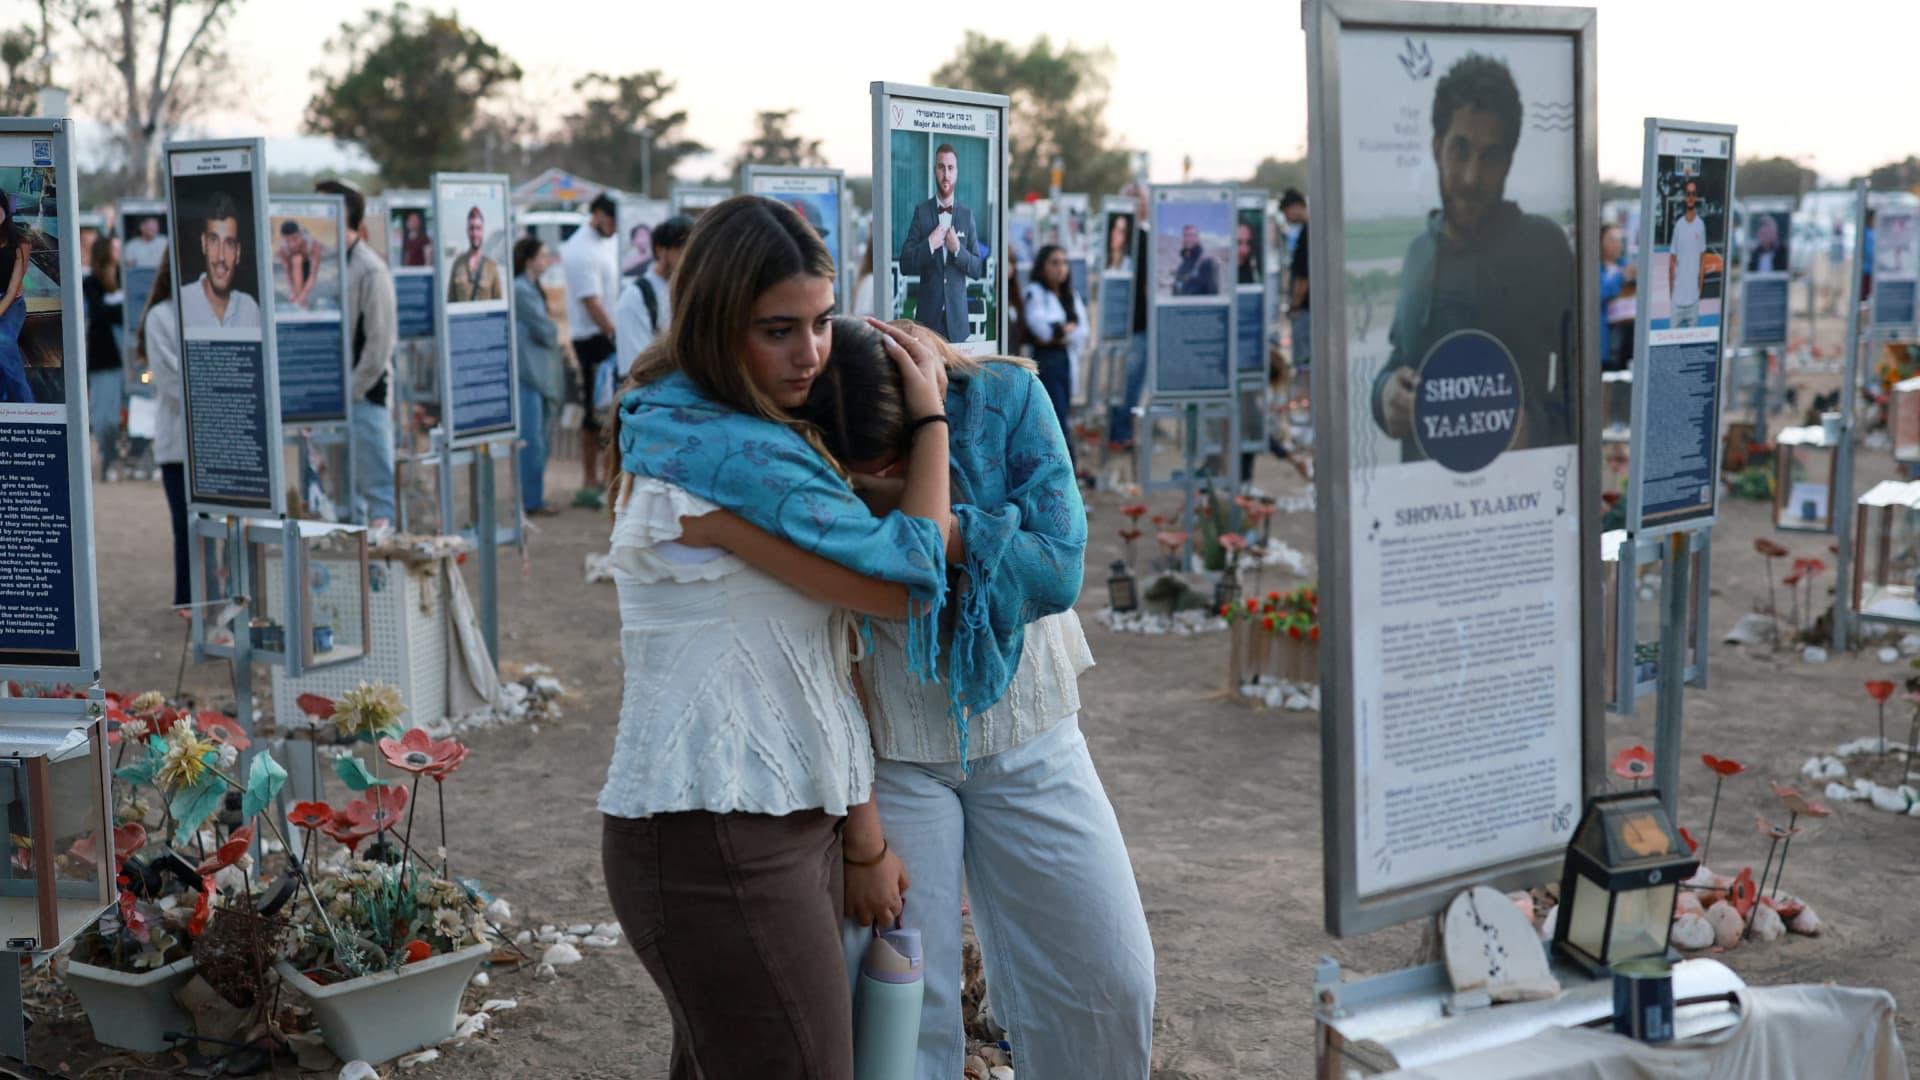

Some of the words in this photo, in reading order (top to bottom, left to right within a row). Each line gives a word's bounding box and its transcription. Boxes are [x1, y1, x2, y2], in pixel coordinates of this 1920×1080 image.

[913, 119, 931, 129] Major
[1424, 373, 1513, 402] SHOVAL
[1423, 407, 1515, 438] YAAKOV
[1394, 502, 1467, 527] SHOVAL
[1469, 491, 1542, 517] YAAKOV
[26, 589, 35, 597] by
